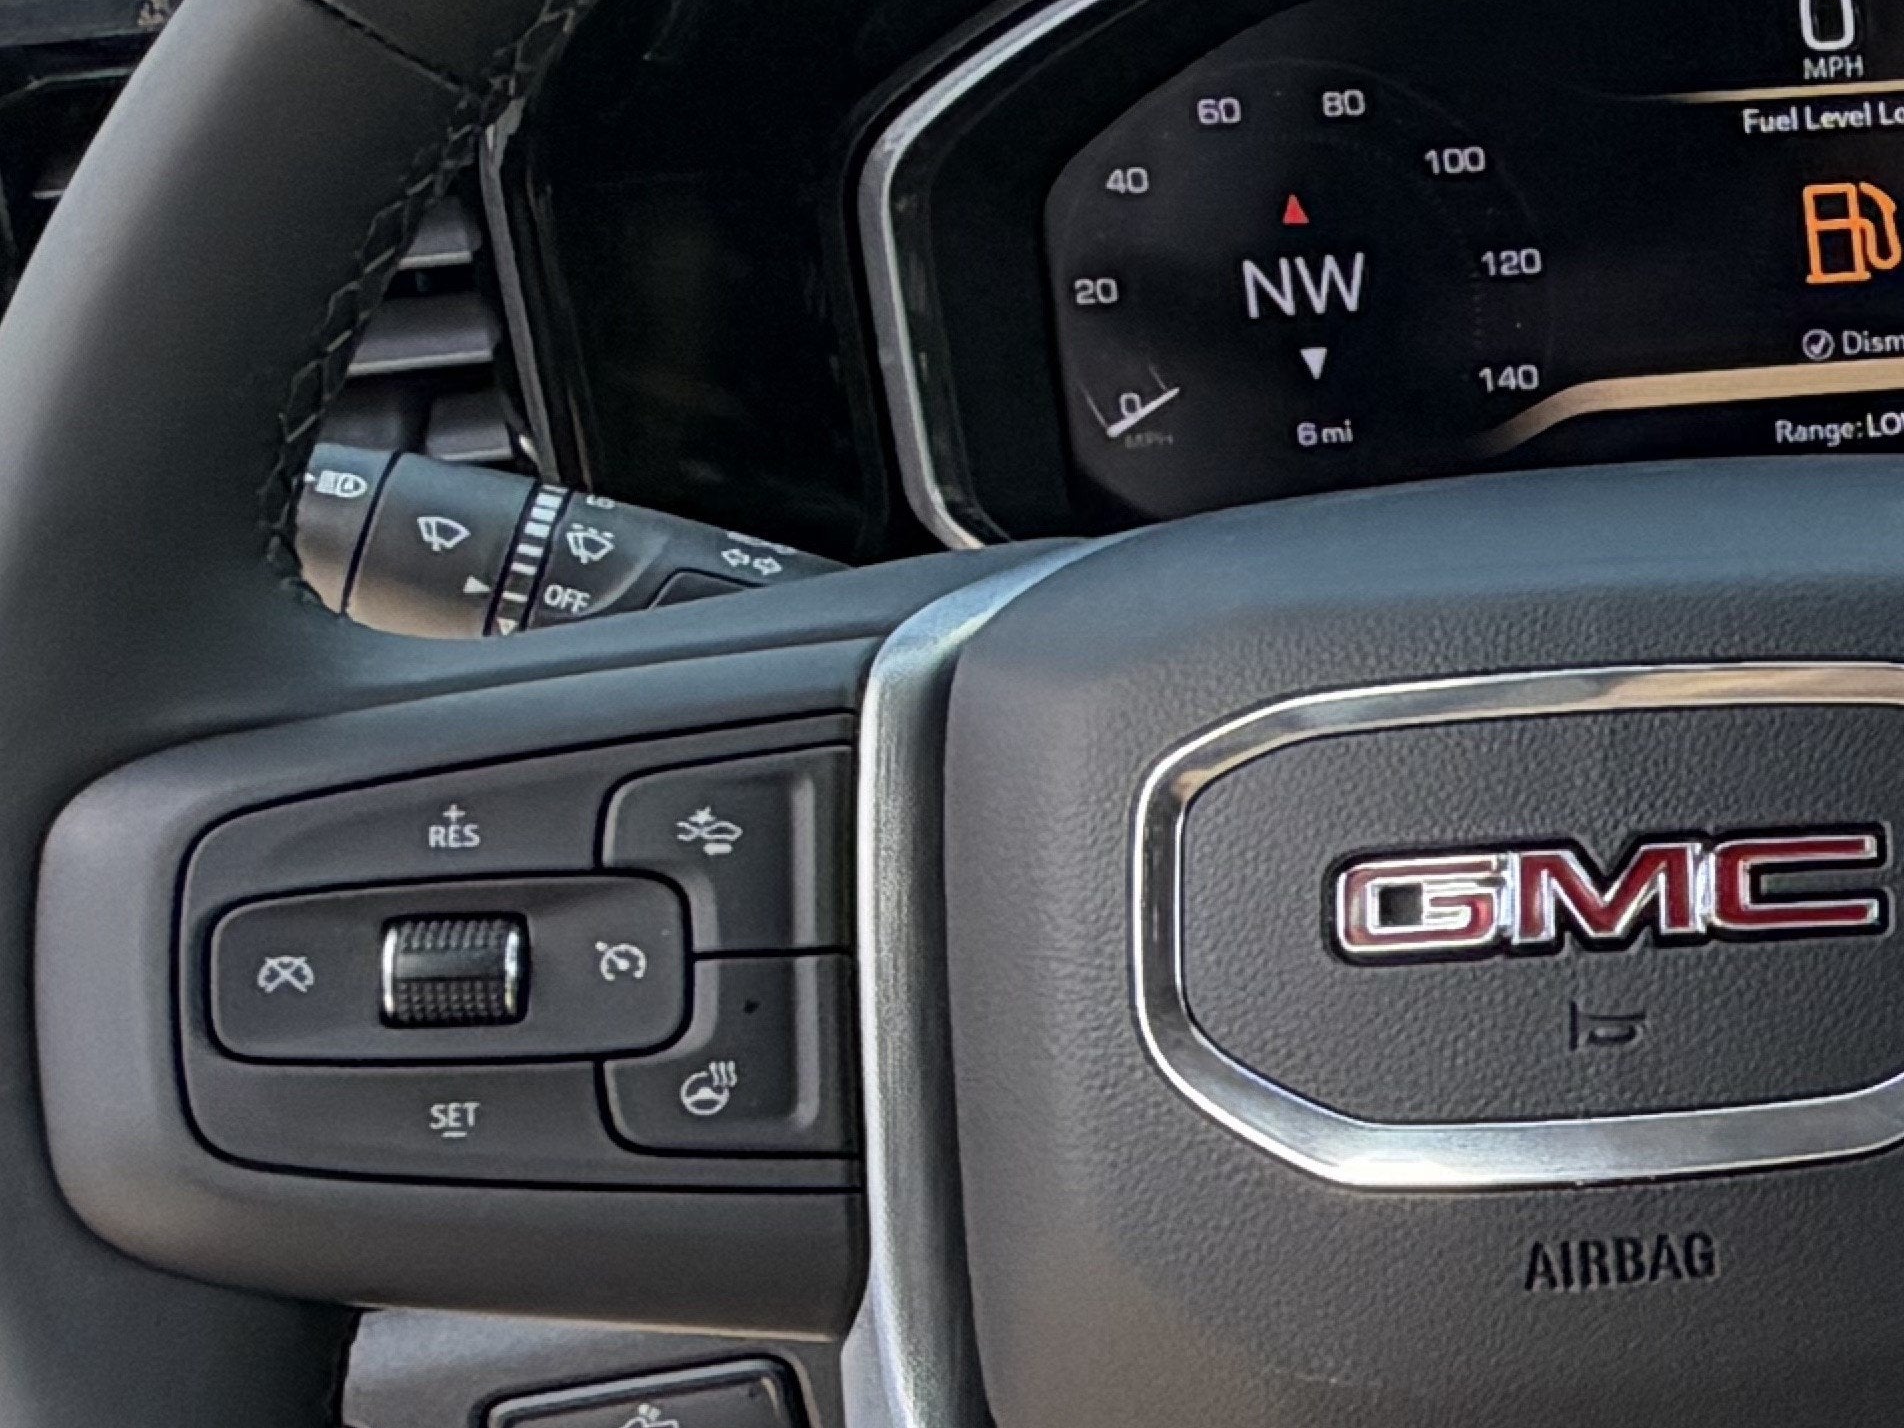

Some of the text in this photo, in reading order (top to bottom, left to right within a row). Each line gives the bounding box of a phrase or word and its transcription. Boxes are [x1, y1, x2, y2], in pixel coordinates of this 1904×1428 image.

[1804, 55, 1863, 79] MPH
[1197, 98, 1241, 124] 60
[1323, 90, 1365, 117] 80
[1743, 107, 1797, 133] Fuel
[1805, 101, 1871, 129] Level
[1425, 147, 1485, 173] 100
[1107, 167, 1149, 193] 40
[1483, 249, 1541, 275] 120
[1075, 279, 1117, 305] 20
[1243, 253, 1363, 318] NW
[1479, 365, 1538, 391] 140
[1297, 419, 1353, 446] 6 mi
[1775, 420, 1863, 447] Range:
[544, 583, 591, 613] OFF
[429, 825, 479, 847] RES
[1337, 832, 1882, 954] GMC
[431, 1103, 479, 1129] SET
[1525, 1231, 1714, 1291] AIRBAG
